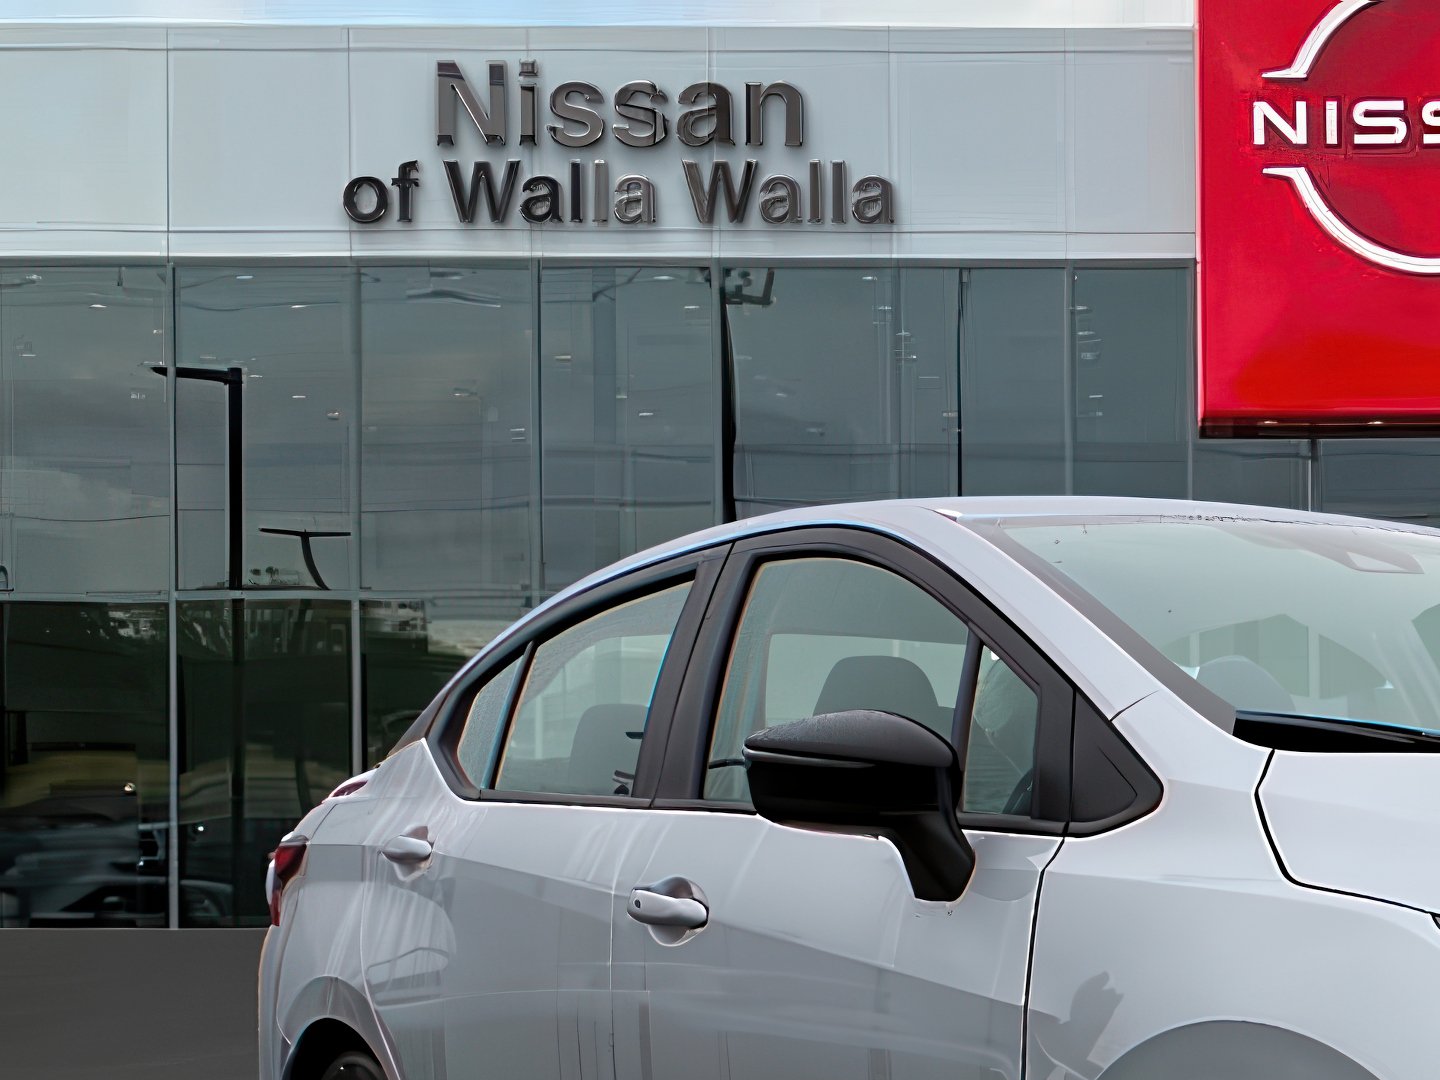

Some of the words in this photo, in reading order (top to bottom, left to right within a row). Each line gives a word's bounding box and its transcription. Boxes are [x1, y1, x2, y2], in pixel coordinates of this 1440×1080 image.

[435, 59, 806, 147] Nissan
[342, 160, 421, 223] of
[442, 158, 658, 225] Walla
[681, 158, 896, 225] Walla
